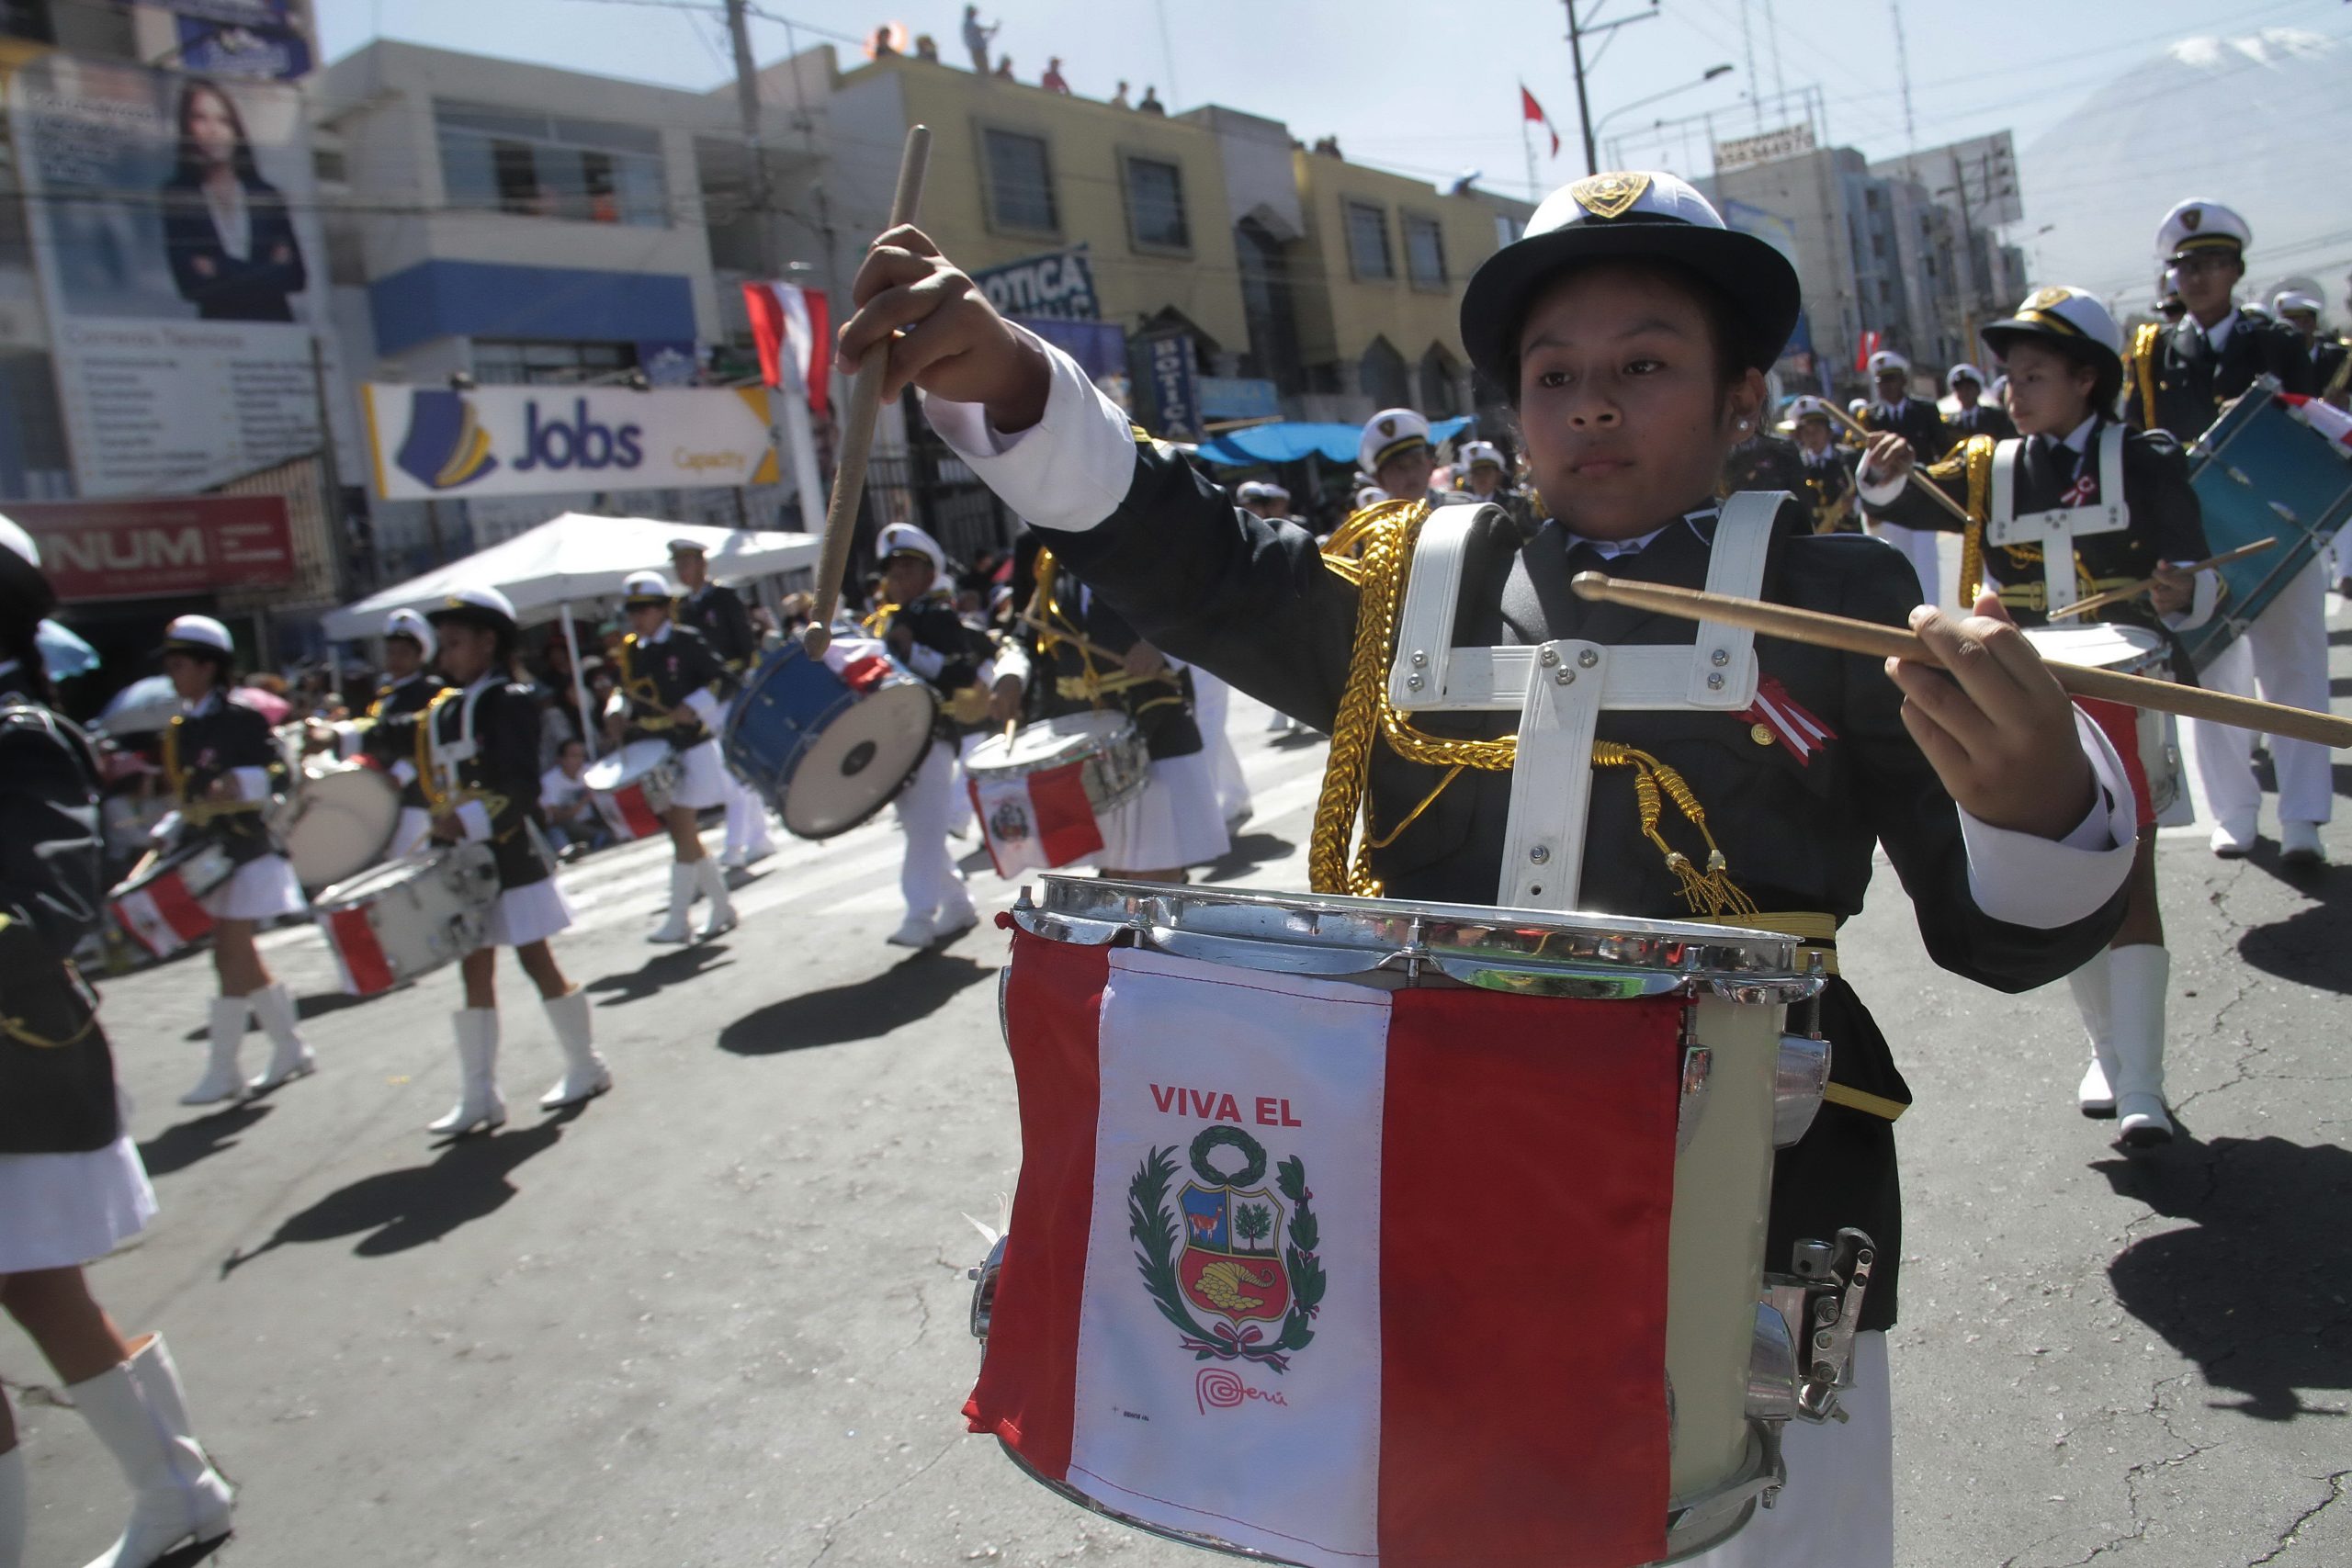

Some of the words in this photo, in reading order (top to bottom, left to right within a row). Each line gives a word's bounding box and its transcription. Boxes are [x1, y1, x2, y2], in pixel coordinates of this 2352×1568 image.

[979, 254, 1088, 313] OTICA
[1154, 338, 1191, 439] BOTICA
[513, 397, 643, 471] Jobs
[1149, 1084, 1242, 1122] VIVA
[1255, 1097, 1302, 1127] EL
[1196, 1368, 1287, 1416] Perú
